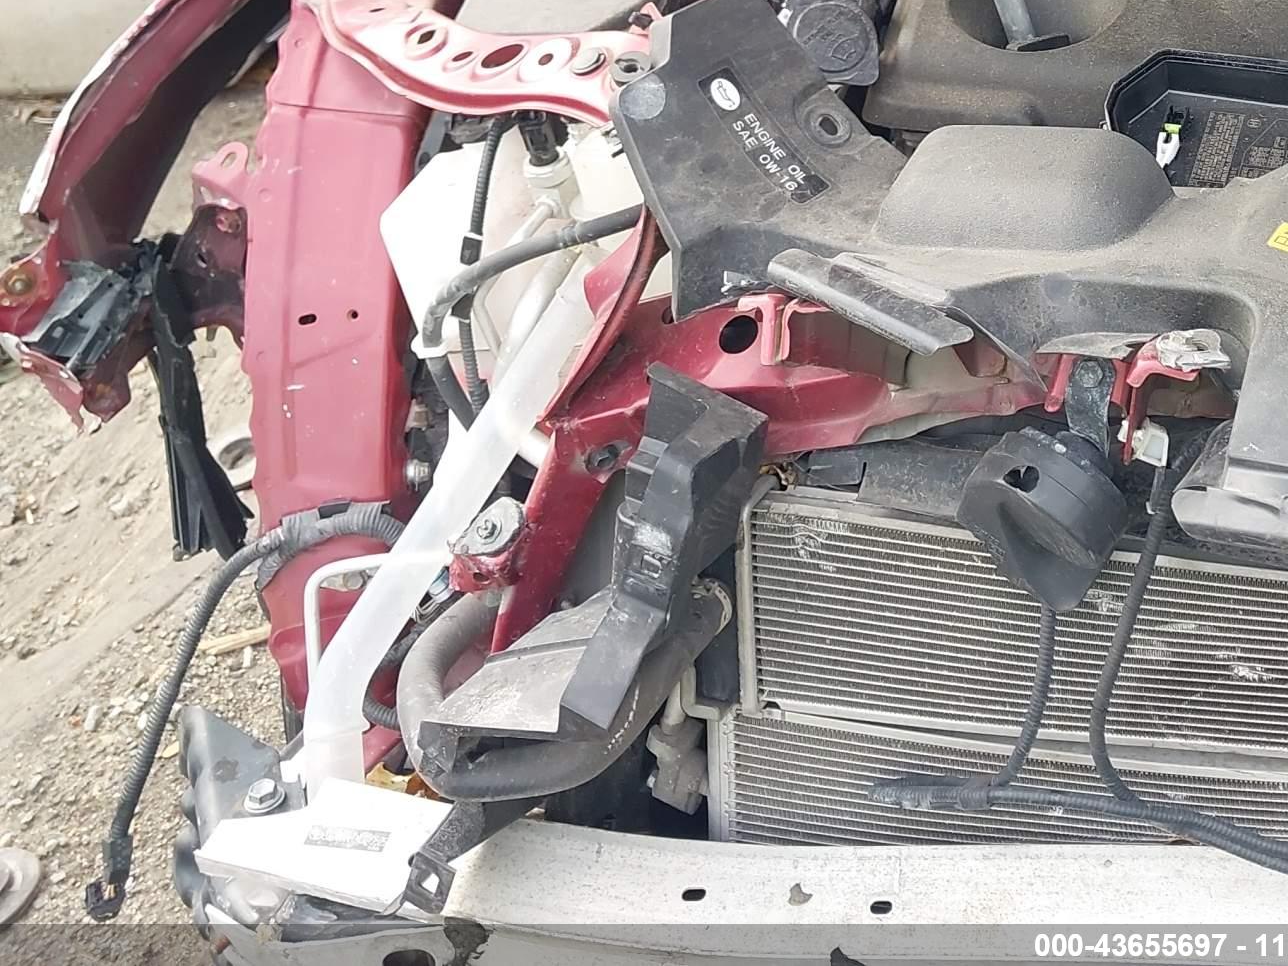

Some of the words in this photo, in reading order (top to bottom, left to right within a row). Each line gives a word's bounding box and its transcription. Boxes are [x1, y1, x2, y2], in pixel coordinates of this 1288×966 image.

[732, 120, 759, 149] SAE
[744, 113, 787, 161] ENGINE
[788, 164, 806, 185] OIL
